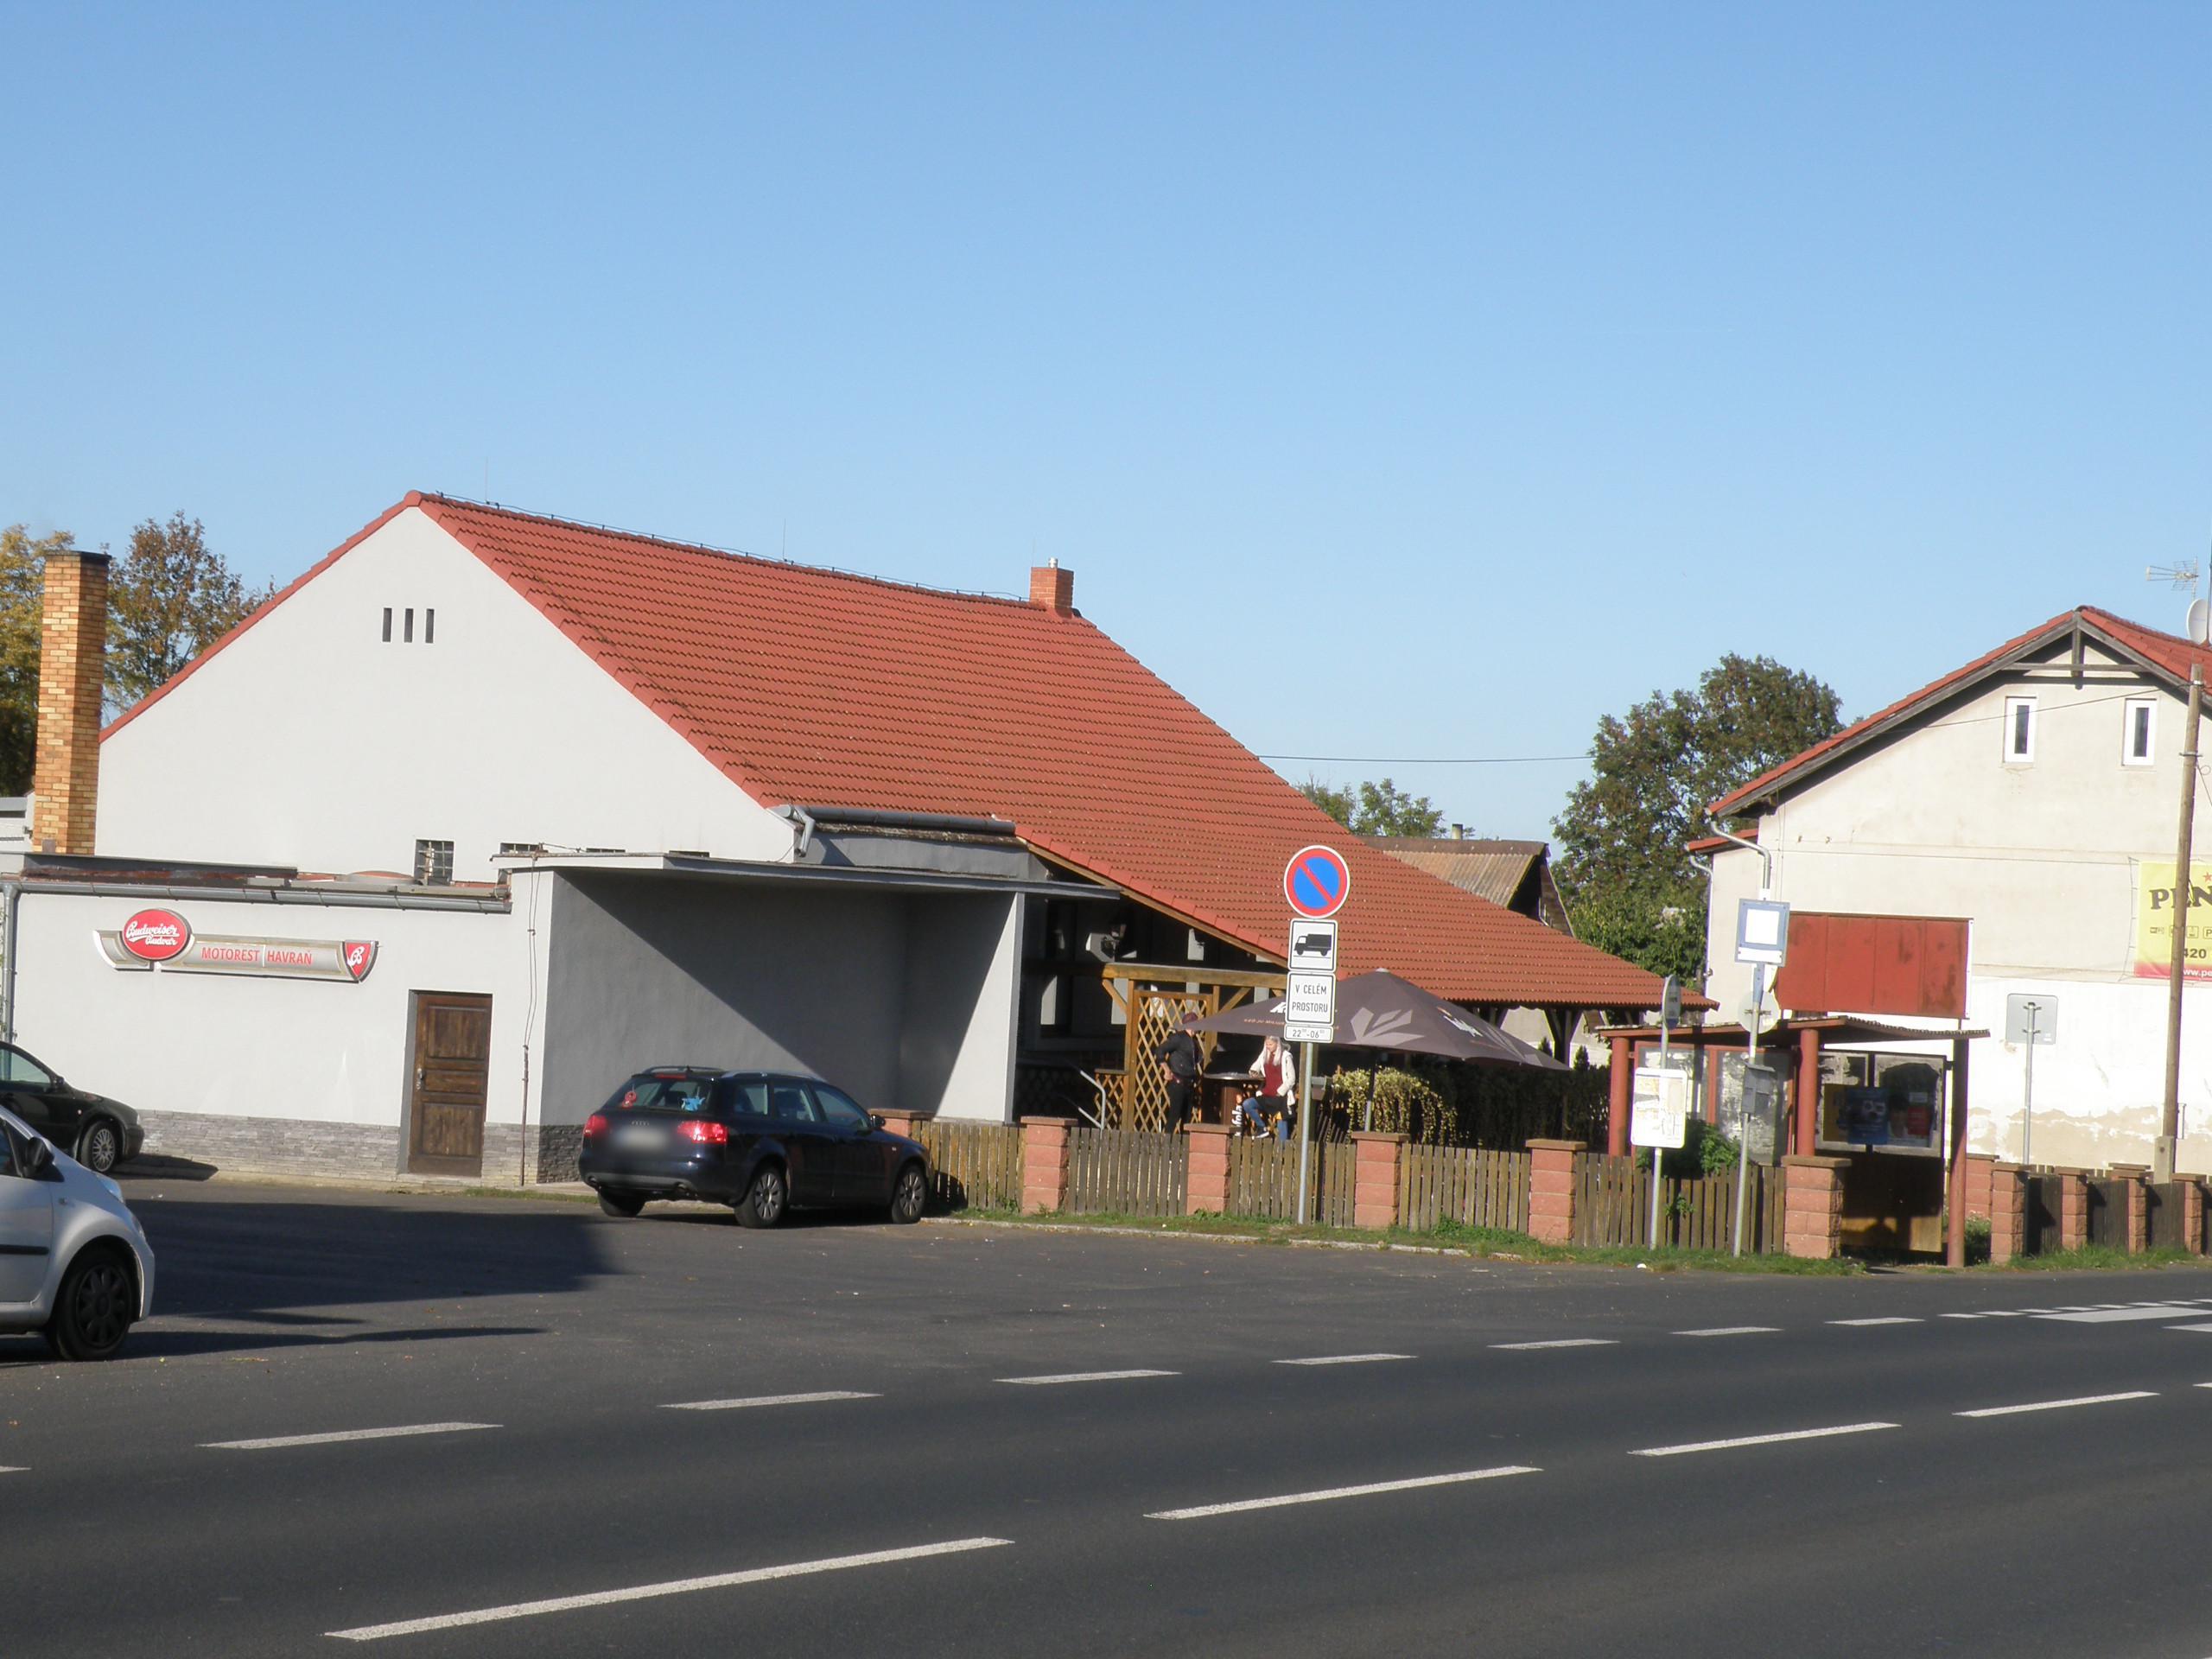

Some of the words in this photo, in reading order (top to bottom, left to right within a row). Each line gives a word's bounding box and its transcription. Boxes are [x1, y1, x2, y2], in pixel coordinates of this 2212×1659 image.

[125, 920, 178, 939] Budweiser
[145, 934, 178, 946] Budvar
[201, 947, 259, 962] MOTOREST
[1295, 984, 1300, 994] V
[1303, 983, 1327, 995] CELÉM
[1292, 1001, 1328, 1013] PROSTORU
